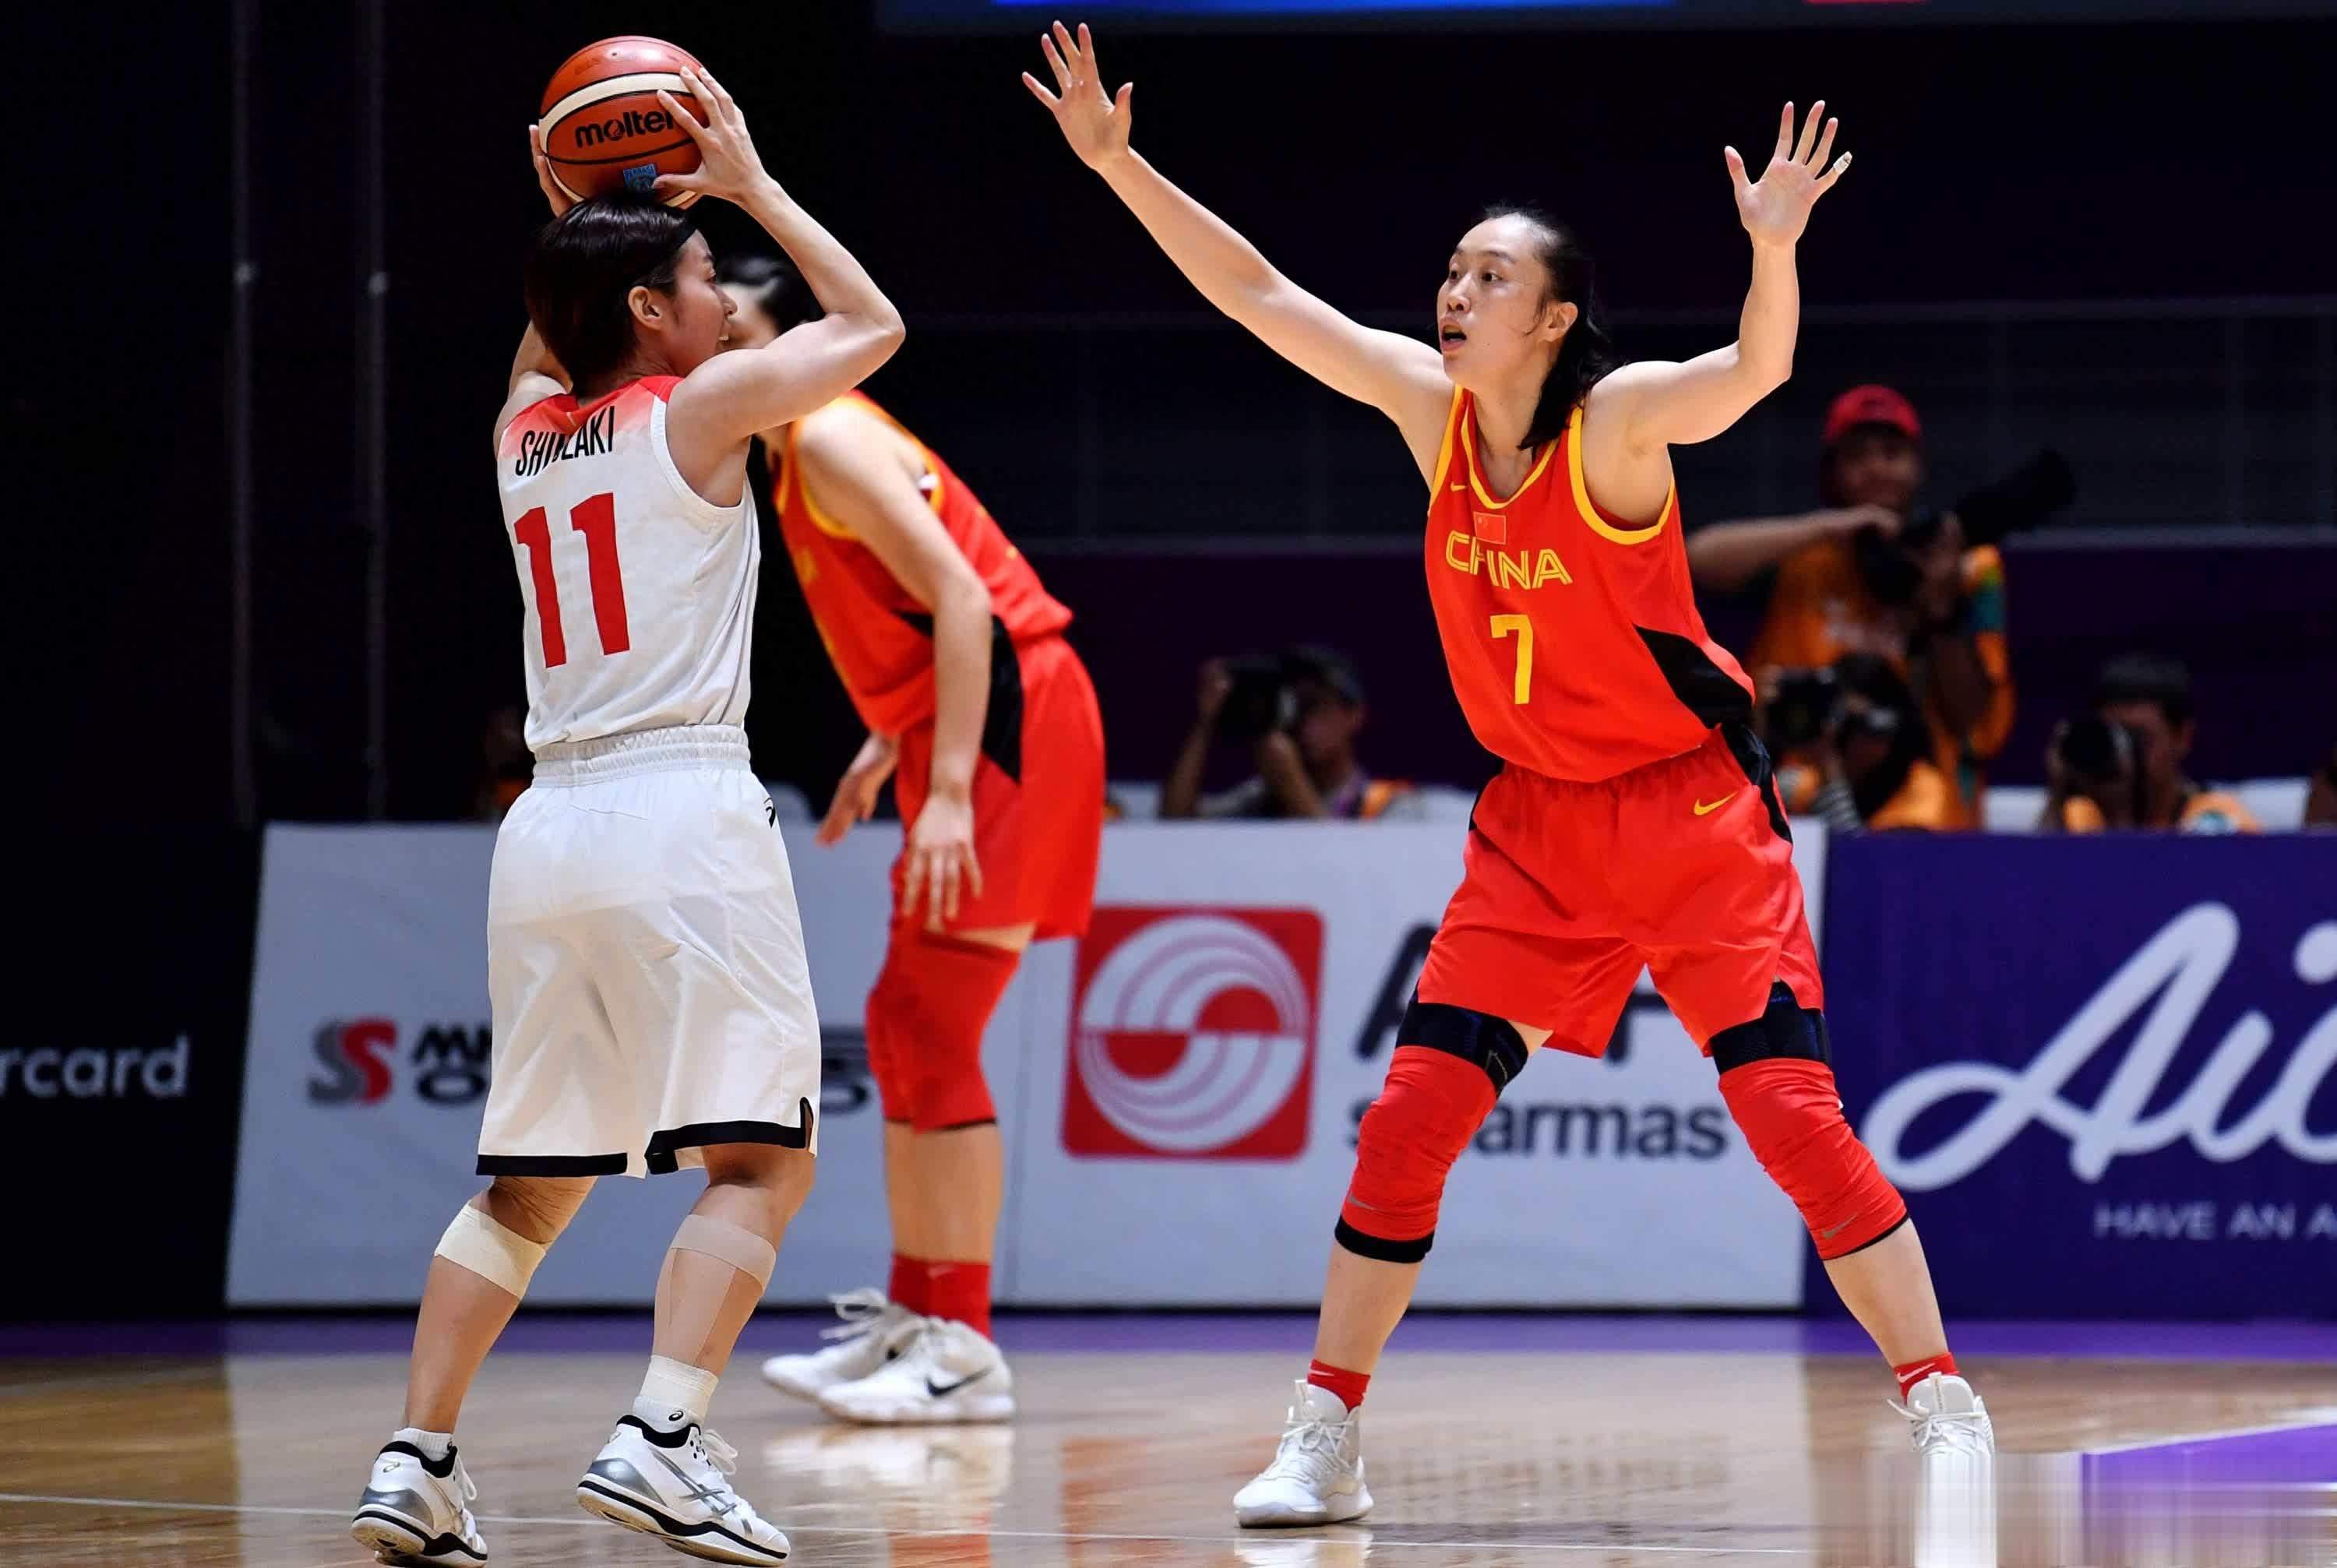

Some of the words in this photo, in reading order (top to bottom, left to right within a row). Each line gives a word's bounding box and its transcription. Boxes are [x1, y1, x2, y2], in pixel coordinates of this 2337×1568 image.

[514, 492, 630, 668] 11
[1445, 530, 1574, 590] CHINA
[1489, 614, 1534, 705] 7
[2093, 1200, 2216, 1239] HAVE
[2228, 1200, 2296, 1239] AN
